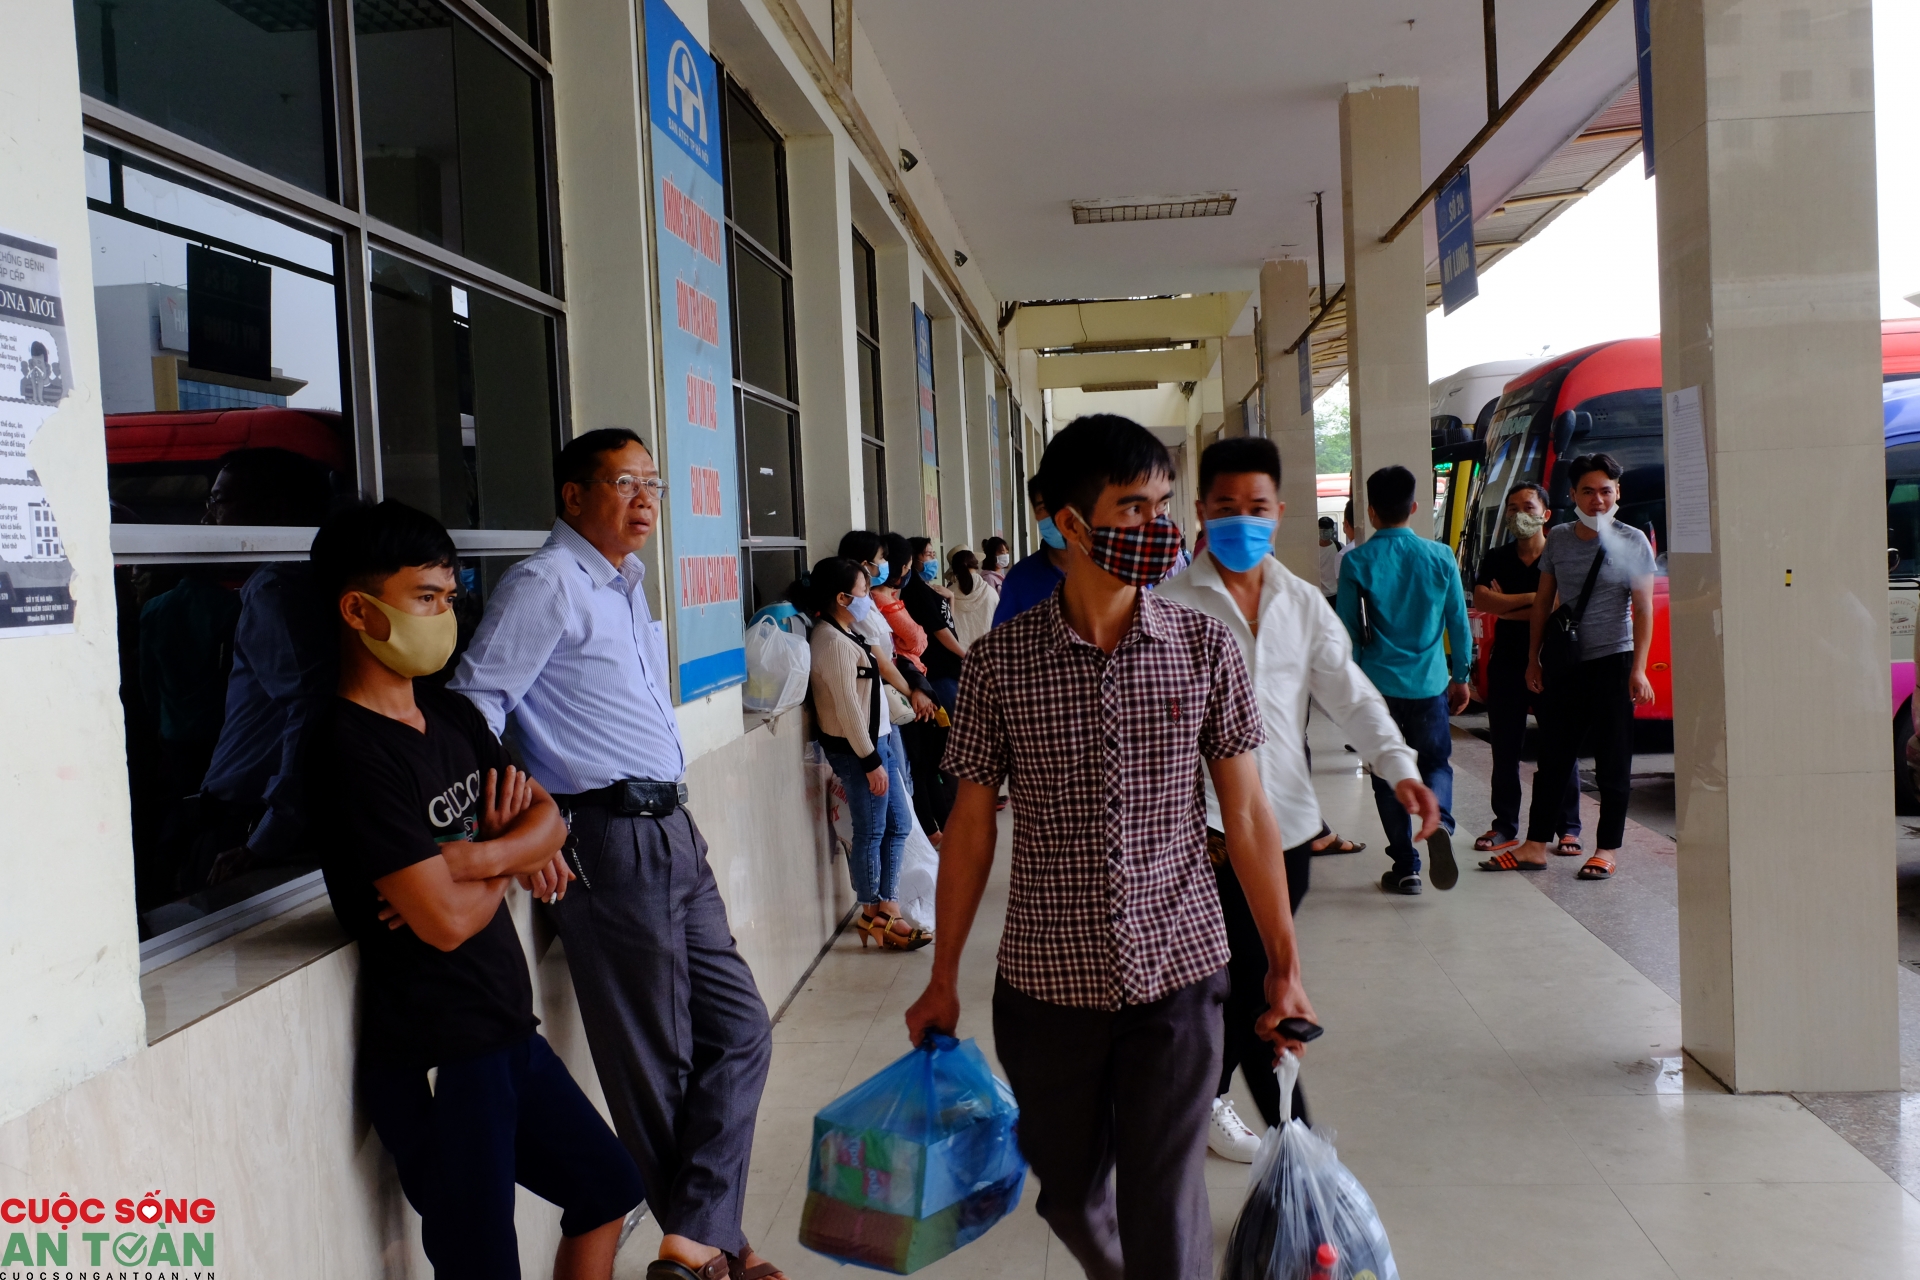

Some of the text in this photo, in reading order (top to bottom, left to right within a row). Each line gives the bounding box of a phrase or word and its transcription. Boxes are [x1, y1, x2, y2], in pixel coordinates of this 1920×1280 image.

[1448, 190, 1456, 223] SỐ
[25, 258, 45, 272] BỆNH
[10, 268, 25, 281] CẤP
[28, 295, 56, 318] MỚI
